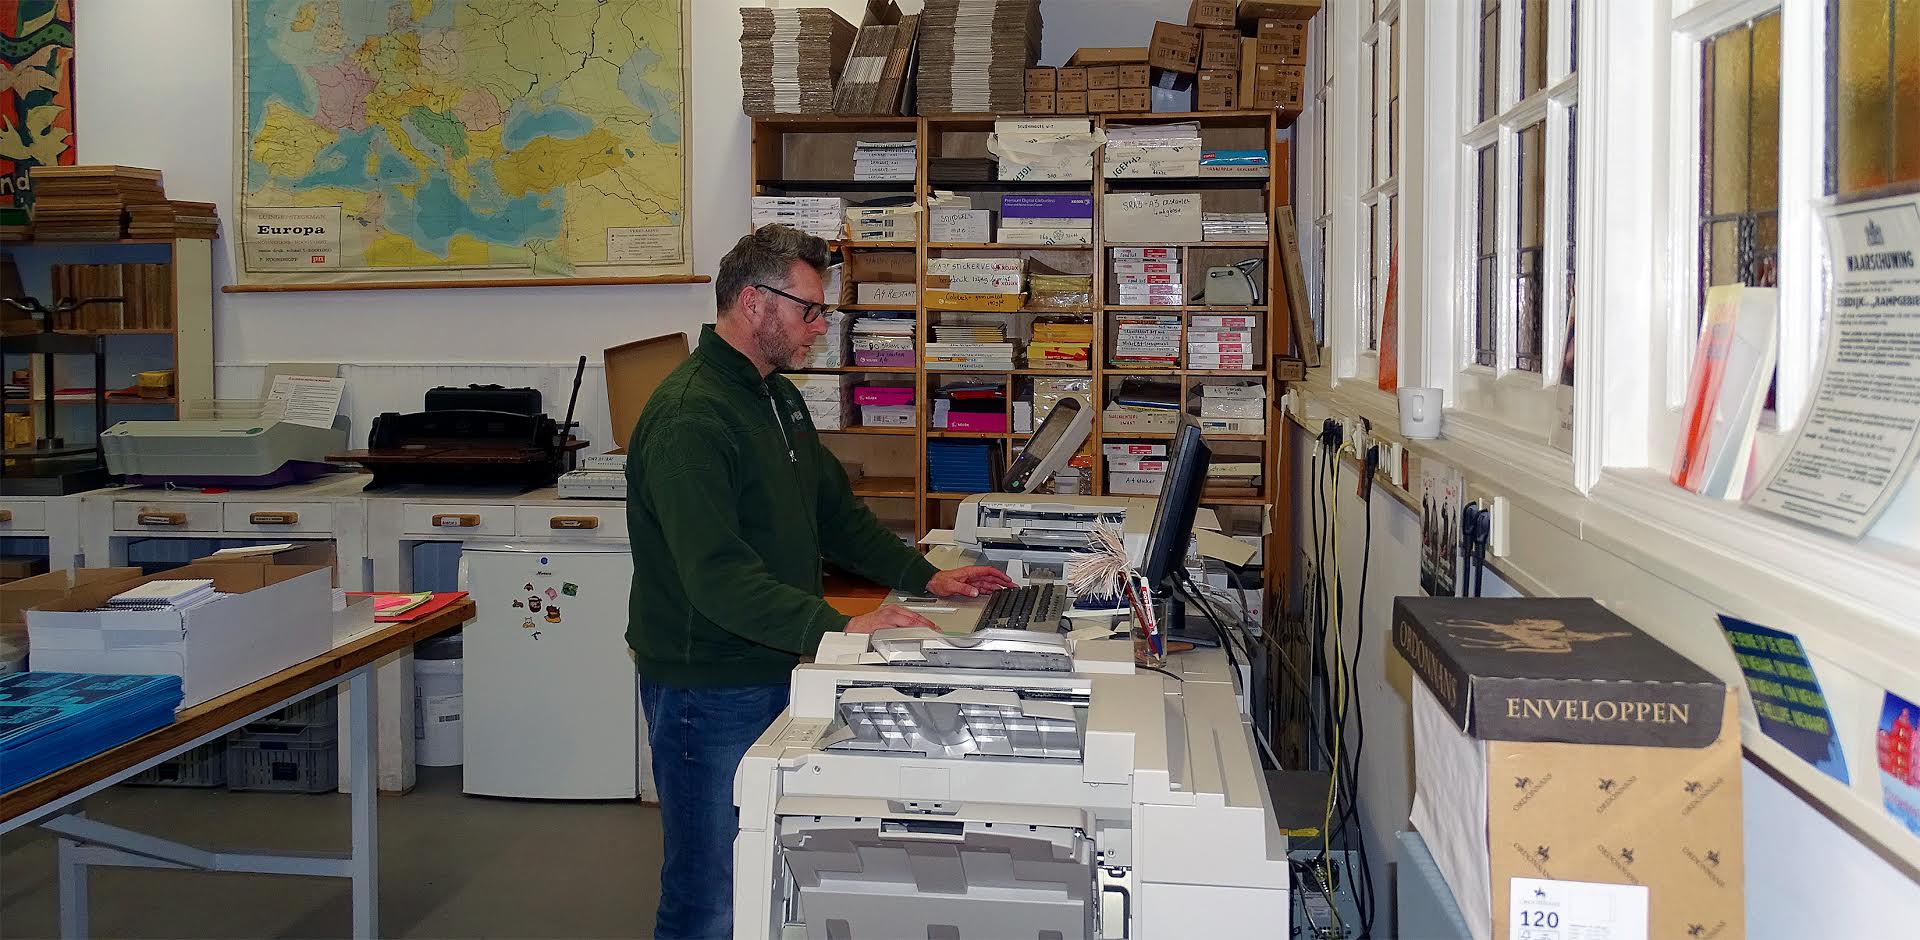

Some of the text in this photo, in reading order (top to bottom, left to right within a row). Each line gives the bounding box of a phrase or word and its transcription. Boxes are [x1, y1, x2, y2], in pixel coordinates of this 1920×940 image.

[257, 225, 326, 236] Europa
[1505, 697, 1691, 726] ENVELOPPEN
[1520, 910, 1559, 928] 120
